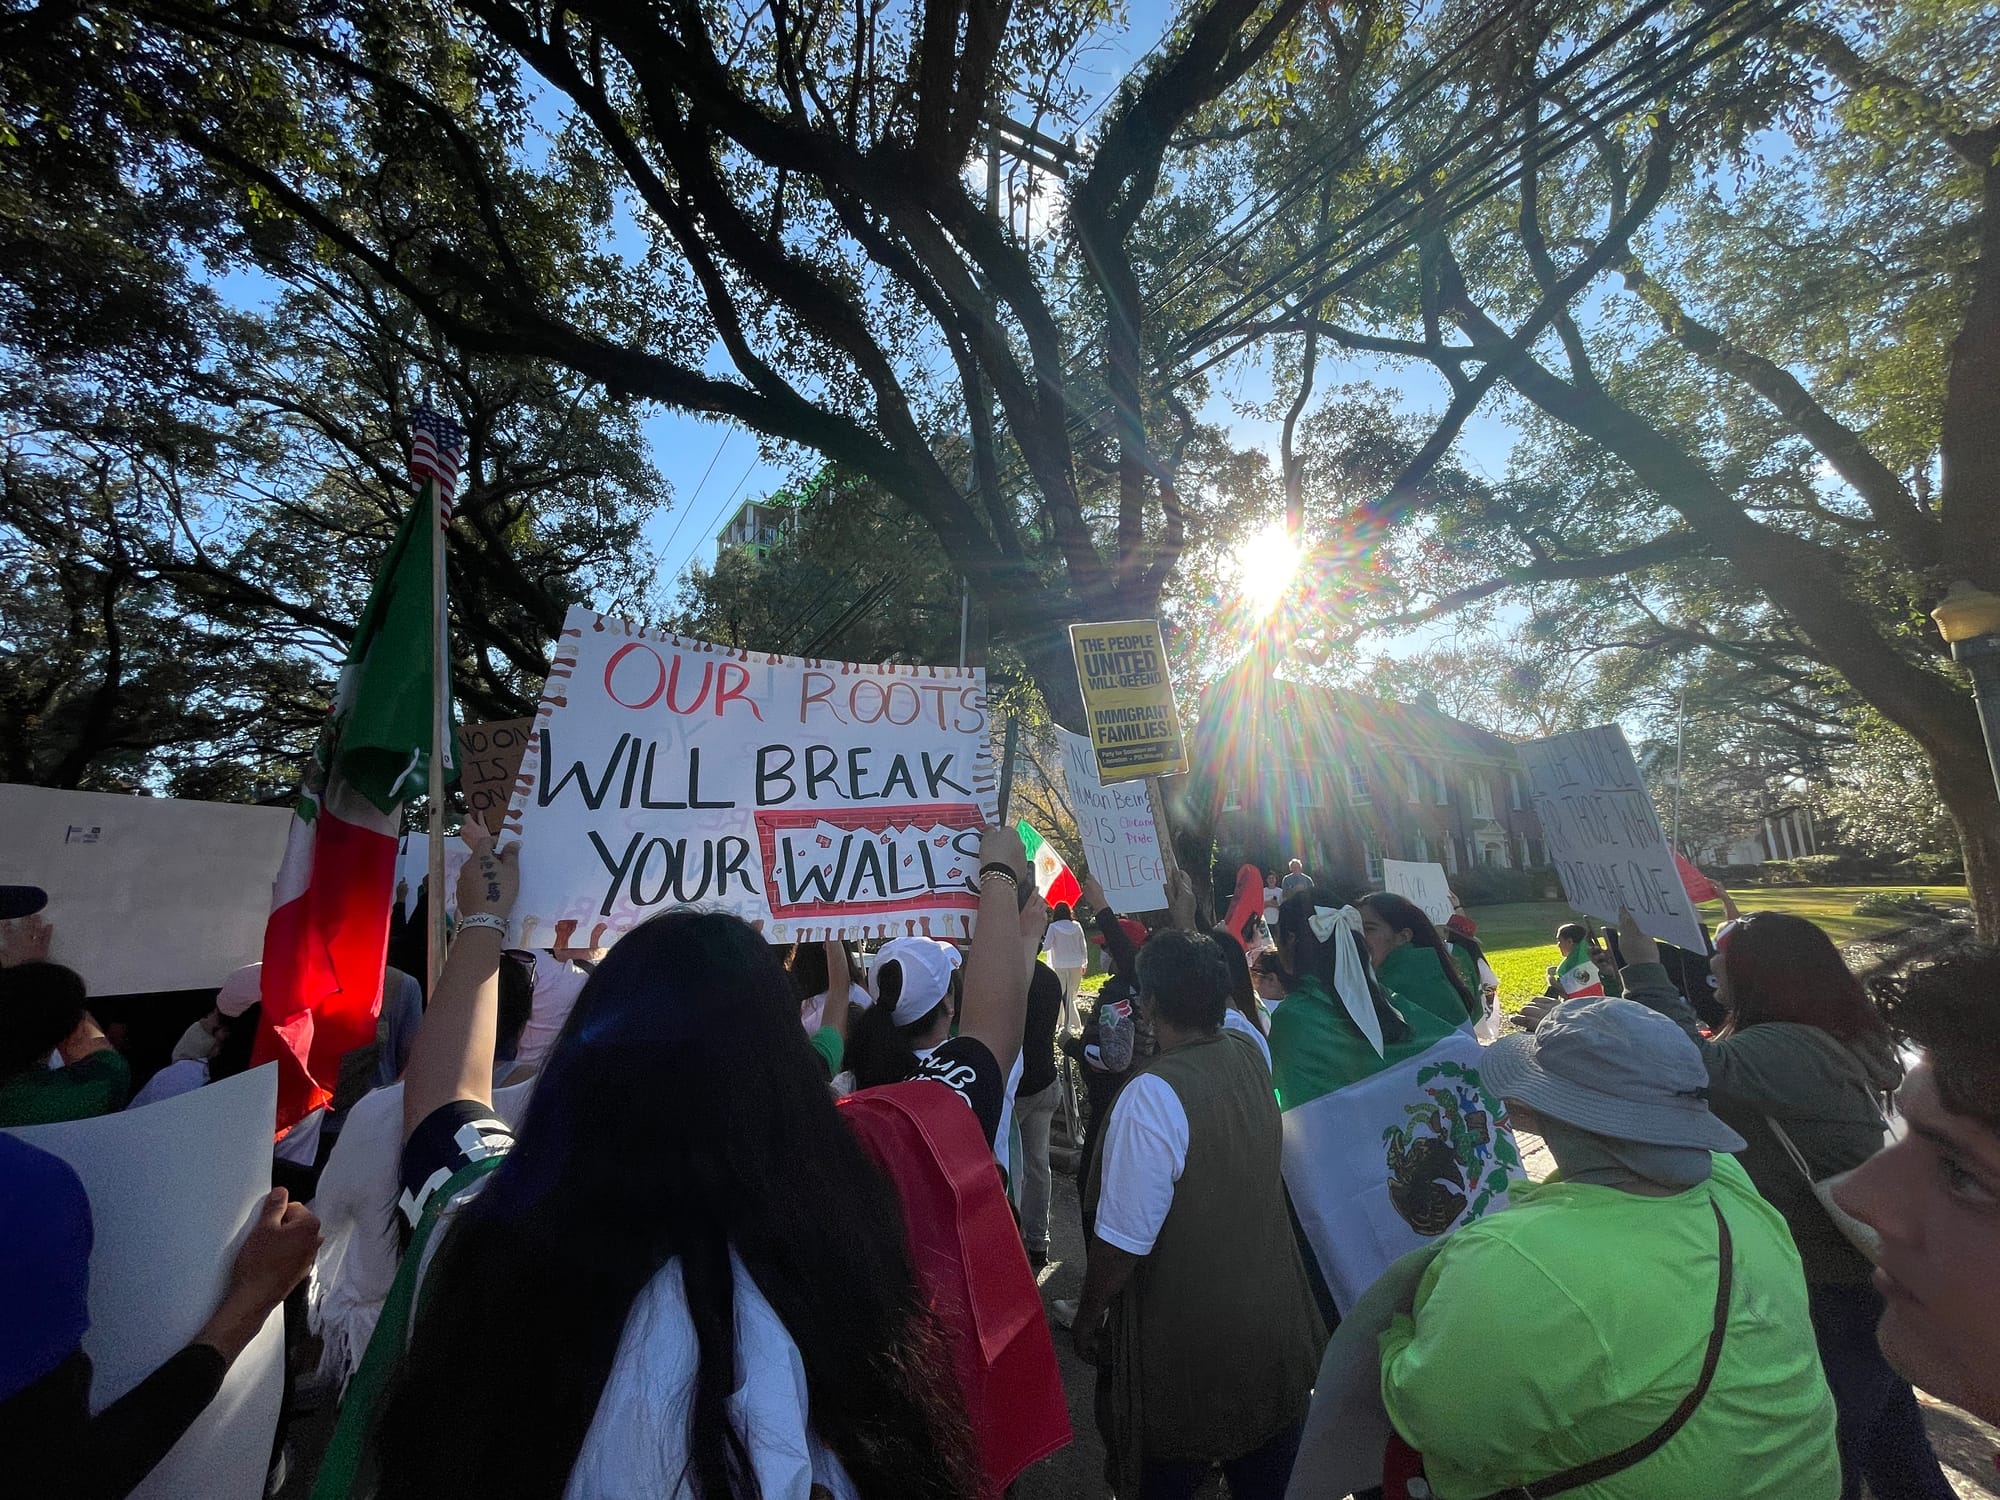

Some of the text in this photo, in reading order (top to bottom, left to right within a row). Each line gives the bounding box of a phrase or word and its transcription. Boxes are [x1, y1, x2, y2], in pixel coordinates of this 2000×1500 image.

[1080, 635, 1154, 653] THE PEOPLE
[1083, 650, 1158, 677] UNITED
[604, 641, 987, 735] OUR ROOTS
[1087, 671, 1162, 690] WILL DEFEND
[1094, 704, 1169, 725] IMMIGRANT
[458, 727, 530, 754] NO ON
[1097, 720, 1172, 745] FAMILIES!
[471, 757, 508, 785] IS
[537, 727, 736, 811] WILL
[755, 743, 972, 806] BREAK
[471, 787, 506, 811] ON
[1094, 816, 1116, 844] IS
[1608, 791, 1661, 849] WHO
[1125, 832, 1153, 845] Pride
[588, 829, 760, 916] YOUR
[781, 830, 984, 902] WALLS
[1087, 844, 1164, 892] ILLEGA
[1628, 860, 1679, 916] ONE
